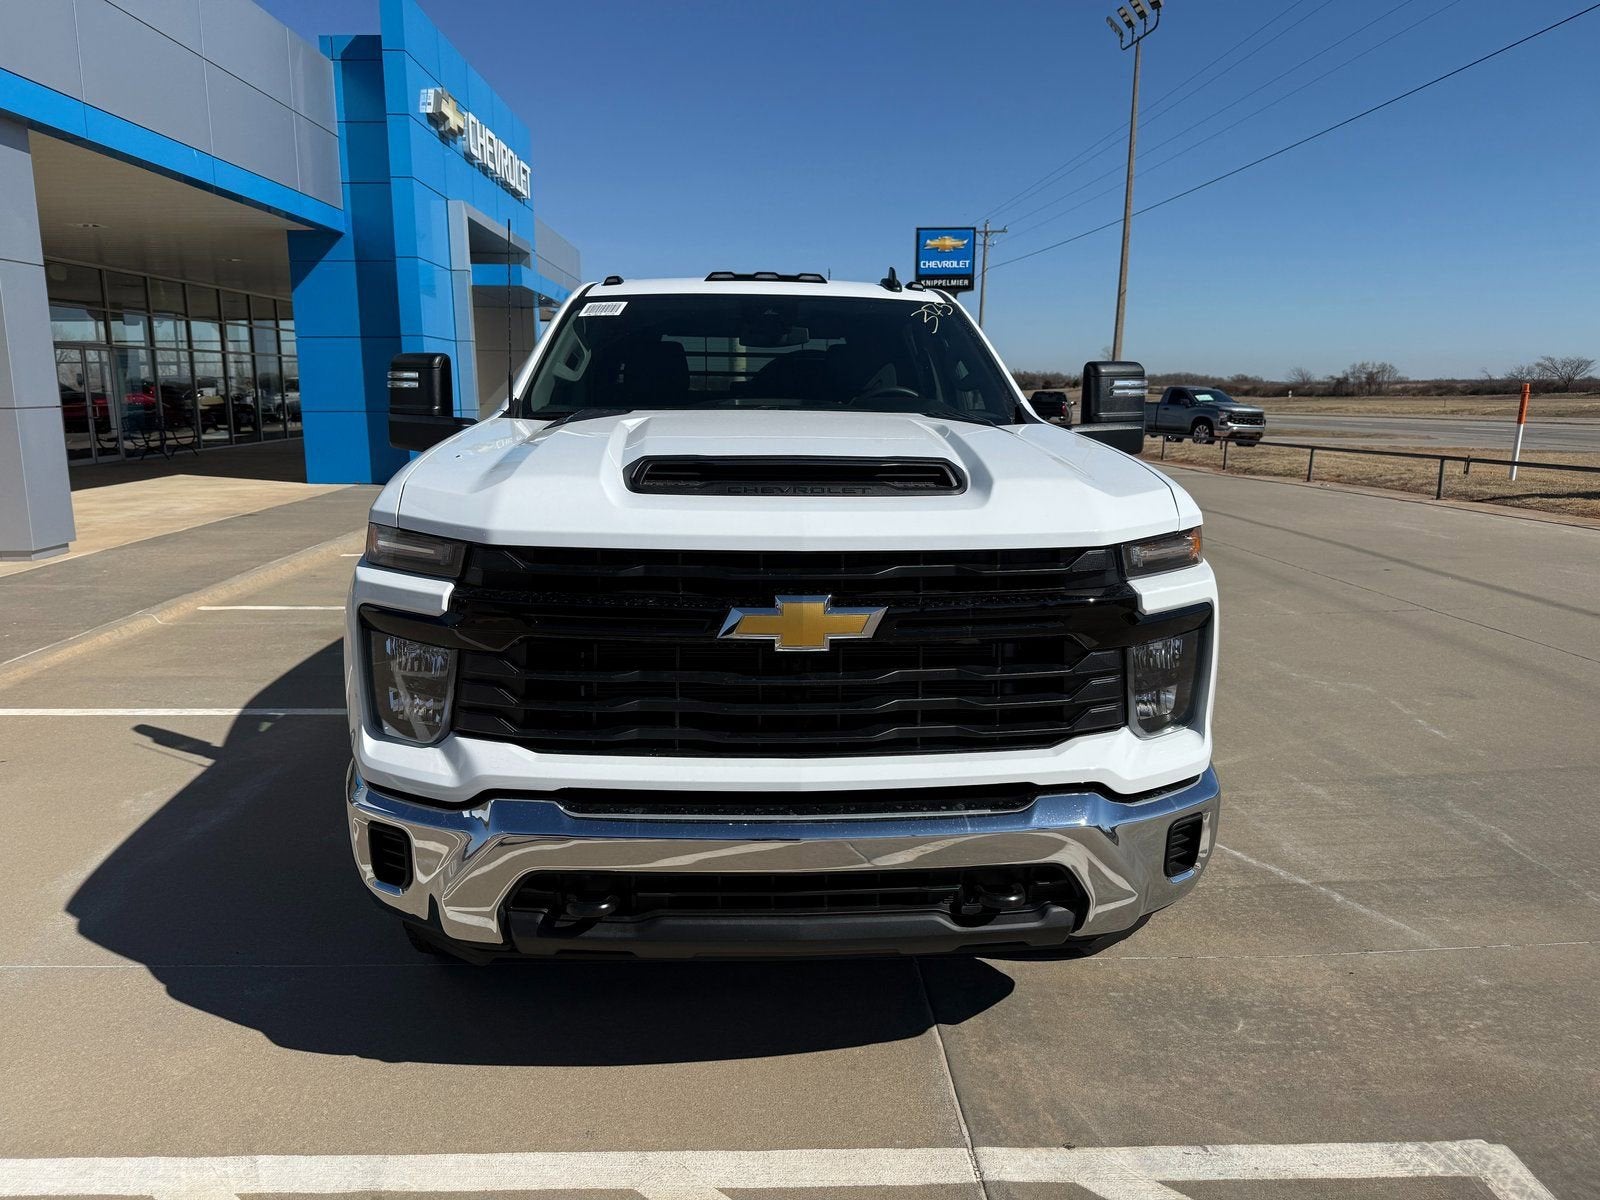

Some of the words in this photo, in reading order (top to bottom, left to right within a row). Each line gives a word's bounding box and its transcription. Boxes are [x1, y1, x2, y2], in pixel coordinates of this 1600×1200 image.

[465, 112, 531, 199] CHEVROLET
[920, 260, 970, 268] CHEVROLET
[727, 486, 872, 495] CHEVROLET
